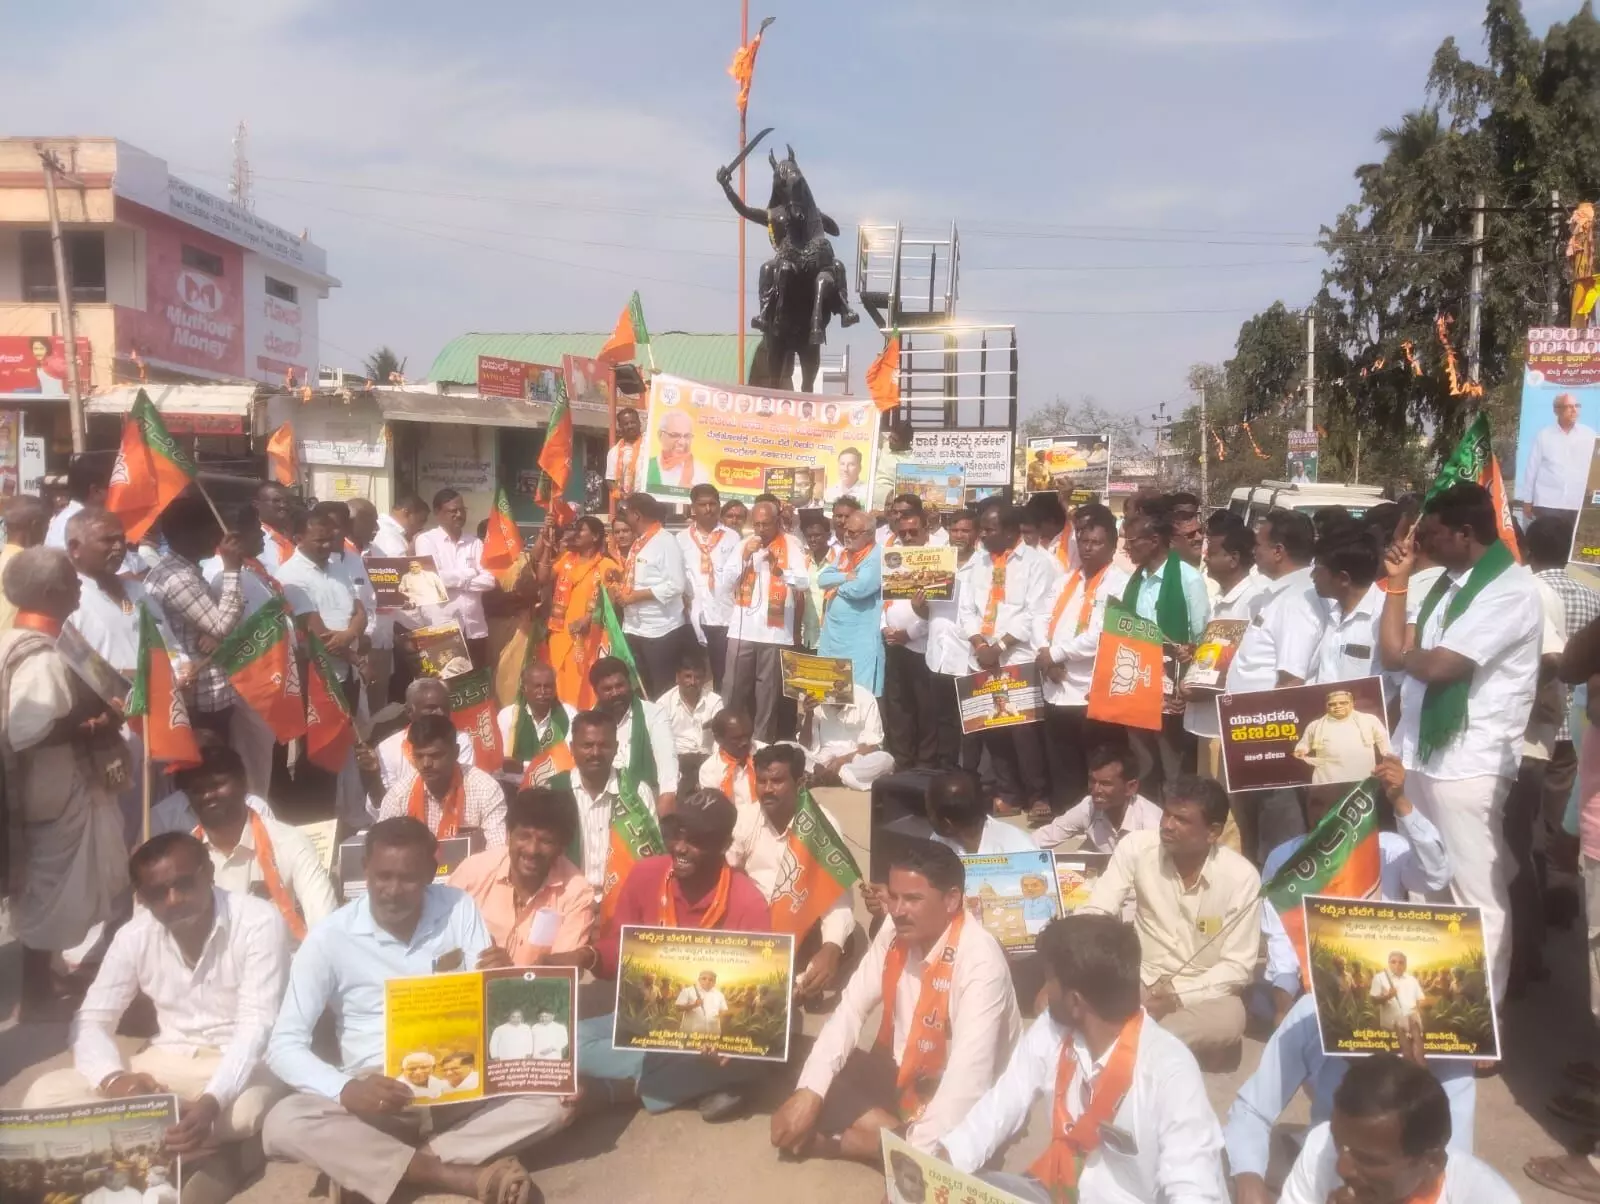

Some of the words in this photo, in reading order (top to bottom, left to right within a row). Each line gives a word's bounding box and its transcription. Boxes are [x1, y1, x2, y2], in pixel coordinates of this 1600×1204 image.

[167, 305, 234, 338] Muthoot
[174, 328, 227, 359] Money
[915, 434, 938, 446] ರಾಣಿ
[1229, 709, 1300, 727] ಯಾವುದಕ್ಕೂ
[1231, 722, 1299, 742] ಹಣವಿಲ್ಲ
